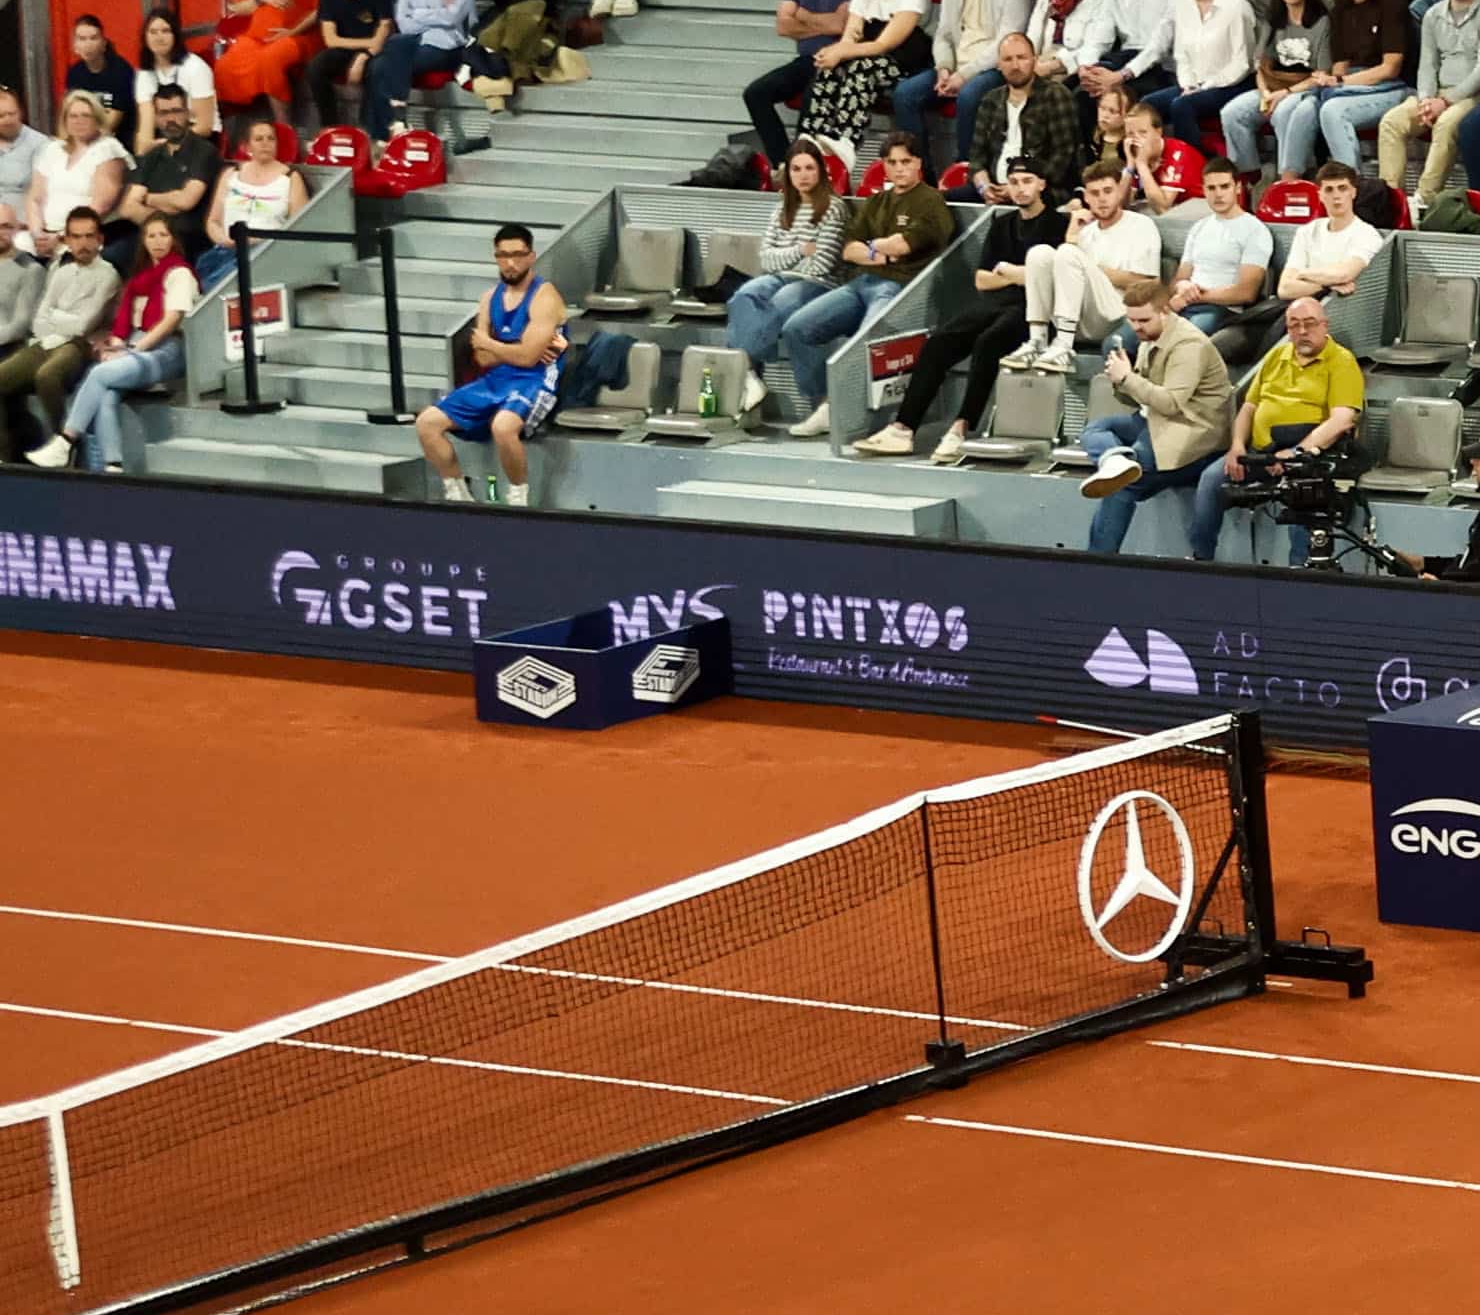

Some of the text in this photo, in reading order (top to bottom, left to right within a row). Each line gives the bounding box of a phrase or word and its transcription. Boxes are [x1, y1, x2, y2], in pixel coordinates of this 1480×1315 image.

[0, 532, 176, 610] NAMAX
[336, 554, 488, 582] GROUPE
[339, 579, 488, 638] GSET
[1213, 630, 1260, 658] AD
[1212, 672, 1341, 709] FACTO
